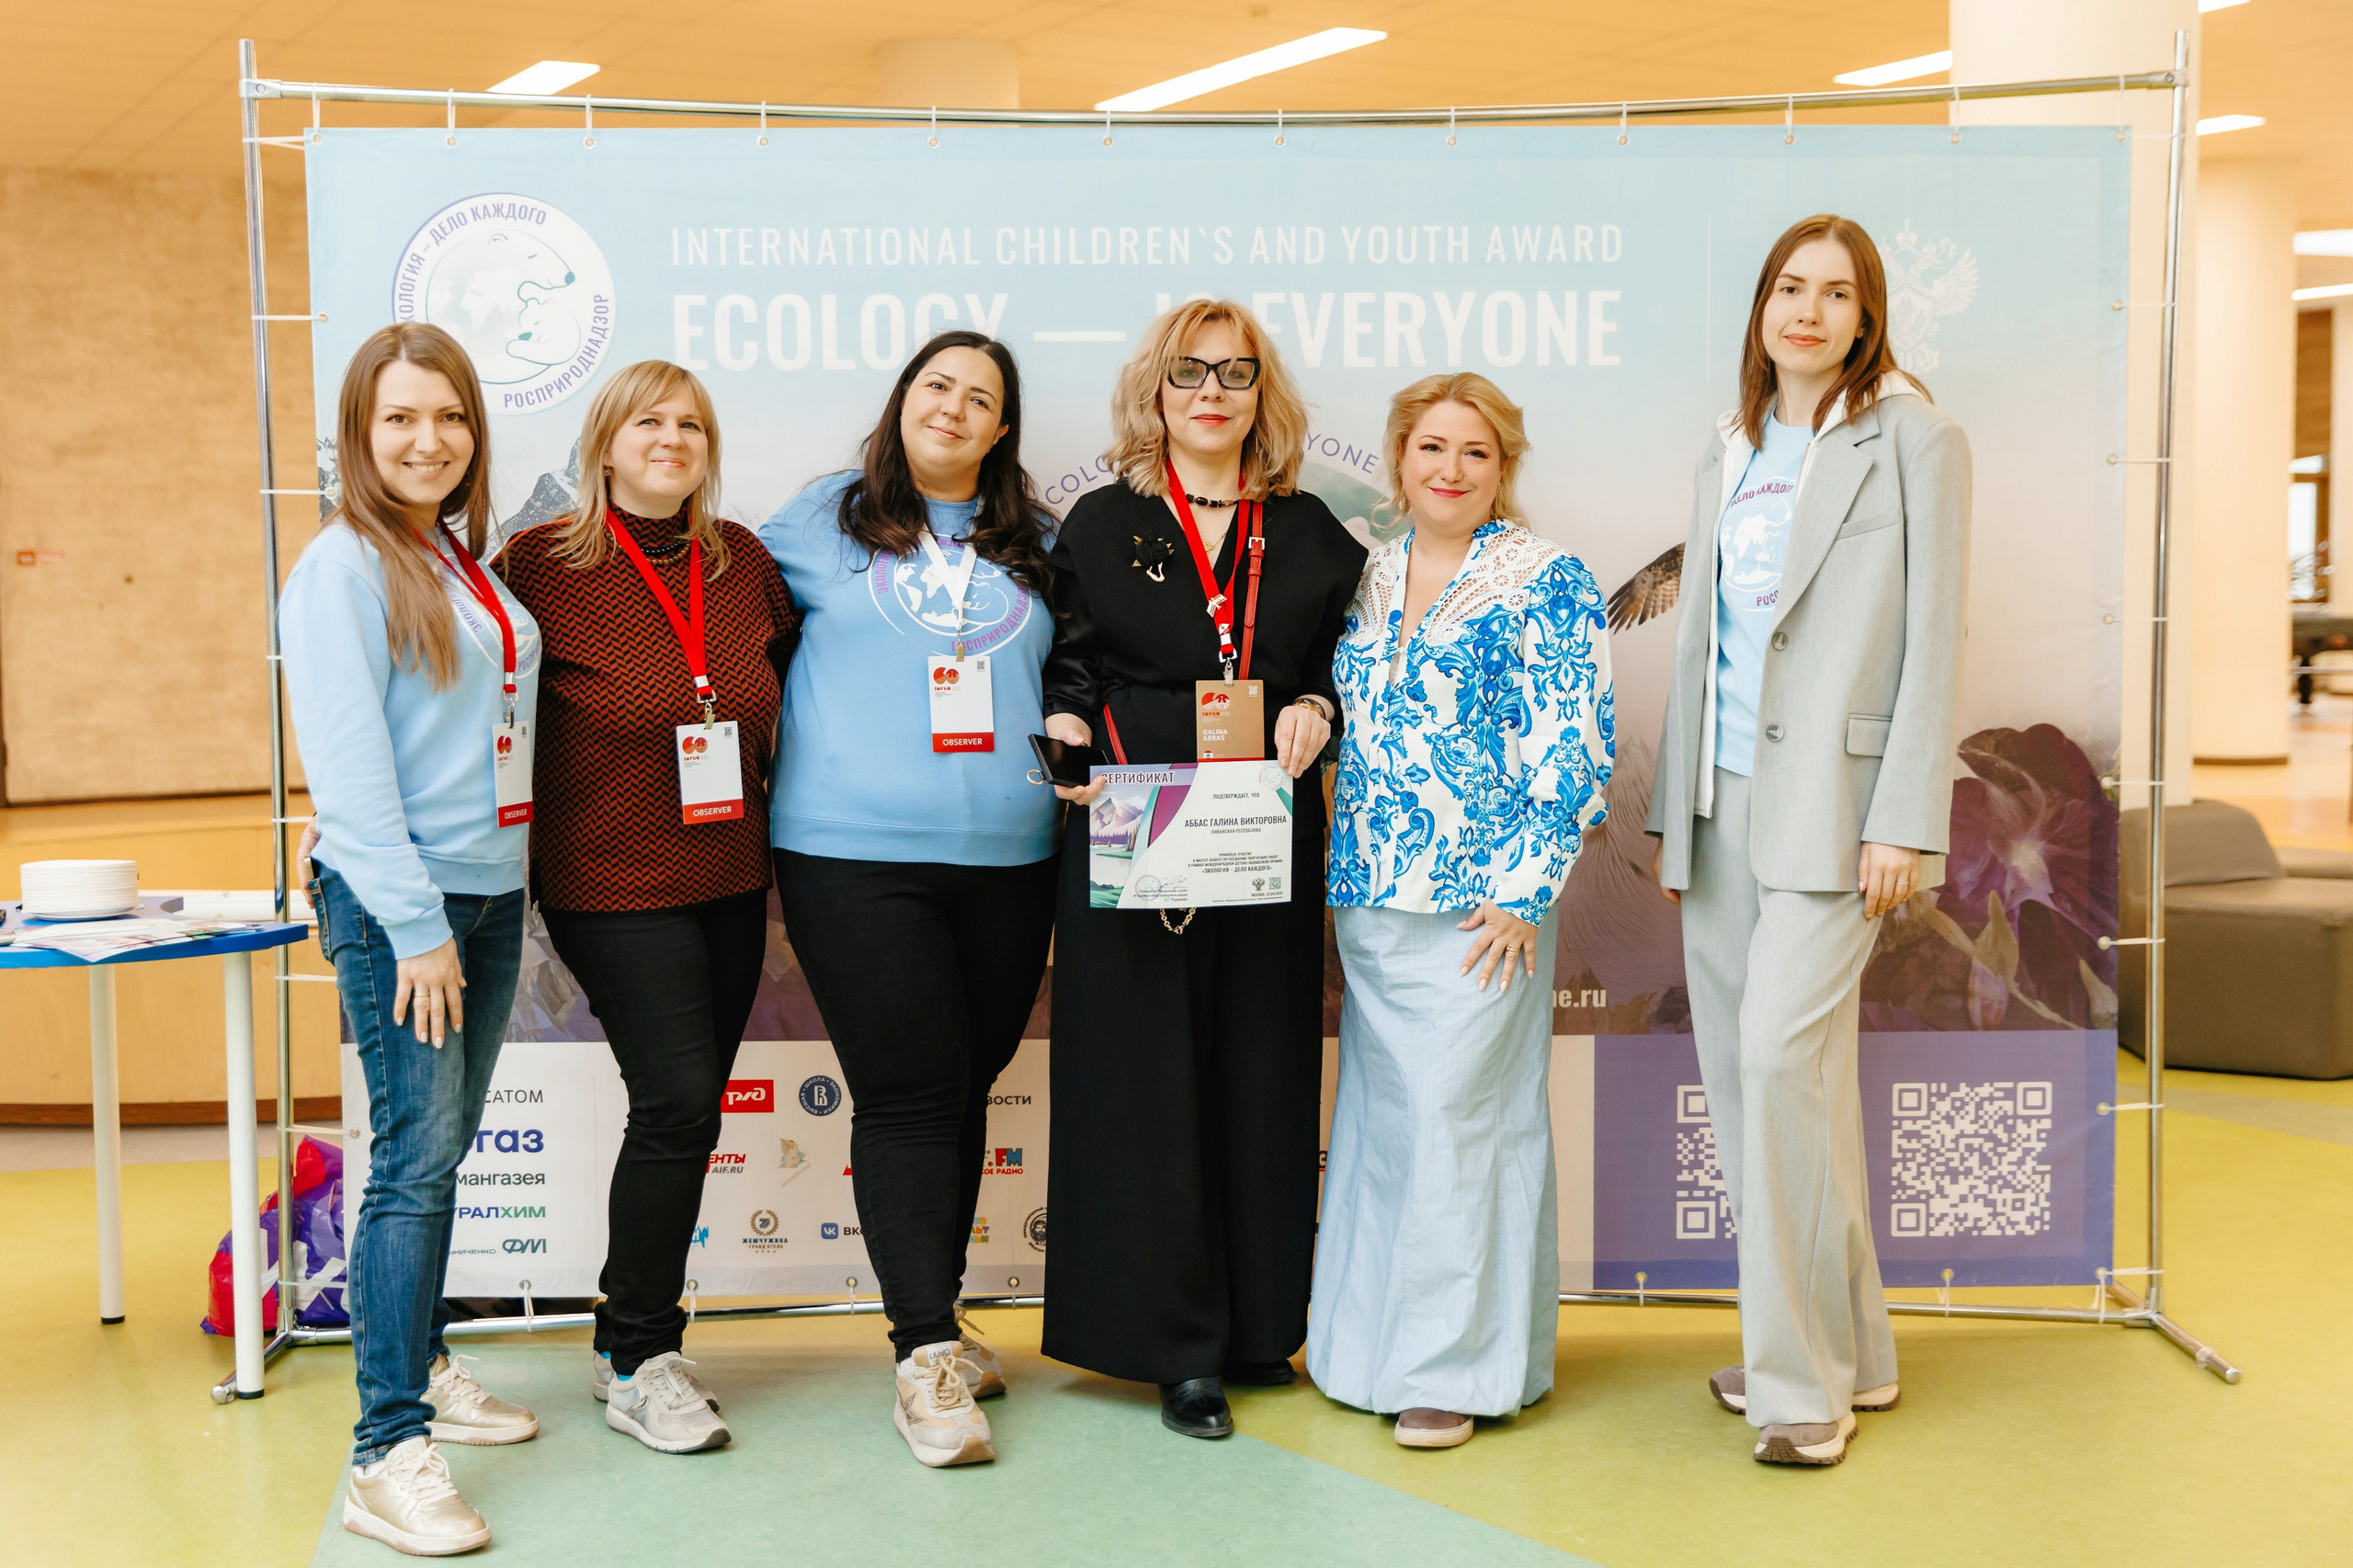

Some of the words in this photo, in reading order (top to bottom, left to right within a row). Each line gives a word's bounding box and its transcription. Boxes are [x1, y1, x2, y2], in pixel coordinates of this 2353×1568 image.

[672, 227, 980, 267] INTERNATIONAL
[1248, 226, 1326, 265] AND
[1341, 225, 1469, 264] YOUTH
[1485, 224, 1623, 264] AWARD
[399, 253, 426, 323] КОЛОГИЯ
[428, 211, 469, 247] ДЕЛО
[470, 202, 547, 225] КАЖДОГО
[504, 294, 609, 409] РОСПРИРОДНАДЗОР
[1307, 431, 1380, 474] YONE
[951, 584, 1029, 653] РСПРИРОДНАДЗО
[942, 738, 983, 746] OBSERVER
[504, 808, 528, 820] OBSERVER
[693, 805, 733, 817] OBSERVER
[1185, 818, 1208, 827] АББАС
[1210, 817, 1238, 827] ГАЛИНА
[1240, 815, 1287, 825] ВИКТОРОВНА
[1552, 989, 1607, 1008] e.ru
[987, 1096, 1032, 1105] ВОСТИ
[466, 1128, 545, 1153] газ
[709, 1153, 747, 1165] ЕНТЫ
[454, 1205, 546, 1219] РАЛХИМ
